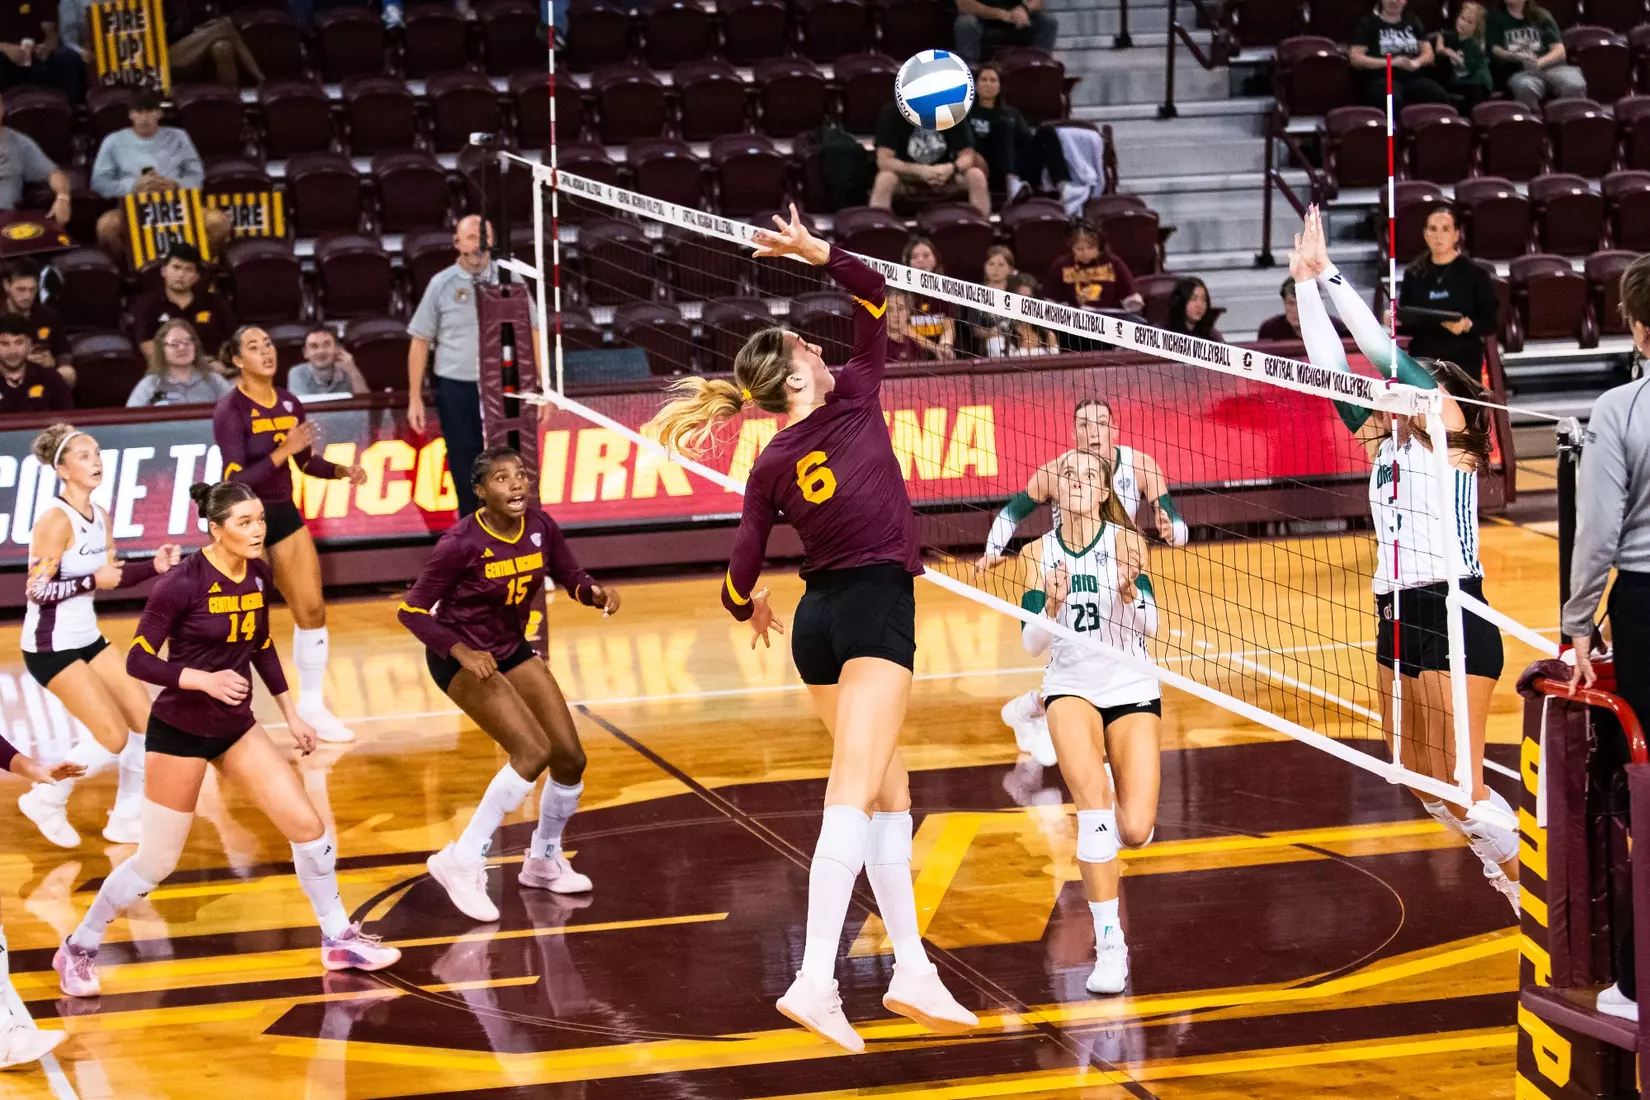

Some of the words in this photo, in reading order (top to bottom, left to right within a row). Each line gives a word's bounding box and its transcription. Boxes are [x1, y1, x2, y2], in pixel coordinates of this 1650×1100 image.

[104, 8, 147, 34] FIRE
[140, 201, 184, 227] FIRE
[1020, 298, 1044, 320] CENTRAL
[1044, 304, 1072, 326] MICHIGAN
[1071, 310, 1106, 335] VOLLEYBALL
[1134, 326, 1161, 349] CENTRAL
[1161, 332, 1192, 356] MICHIGAN
[1192, 339, 1231, 367] VOLLEYBALL
[1264, 357, 1295, 382] CENTRAL
[1296, 364, 1332, 390] MICHIGAN
[1332, 372, 1374, 402] VOLLEYBALL
[796, 450, 837, 504] 6
[504, 574, 533, 606] 15
[1068, 574, 1099, 593] HIO
[226, 610, 257, 643] 14
[1070, 602, 1101, 632] 23
